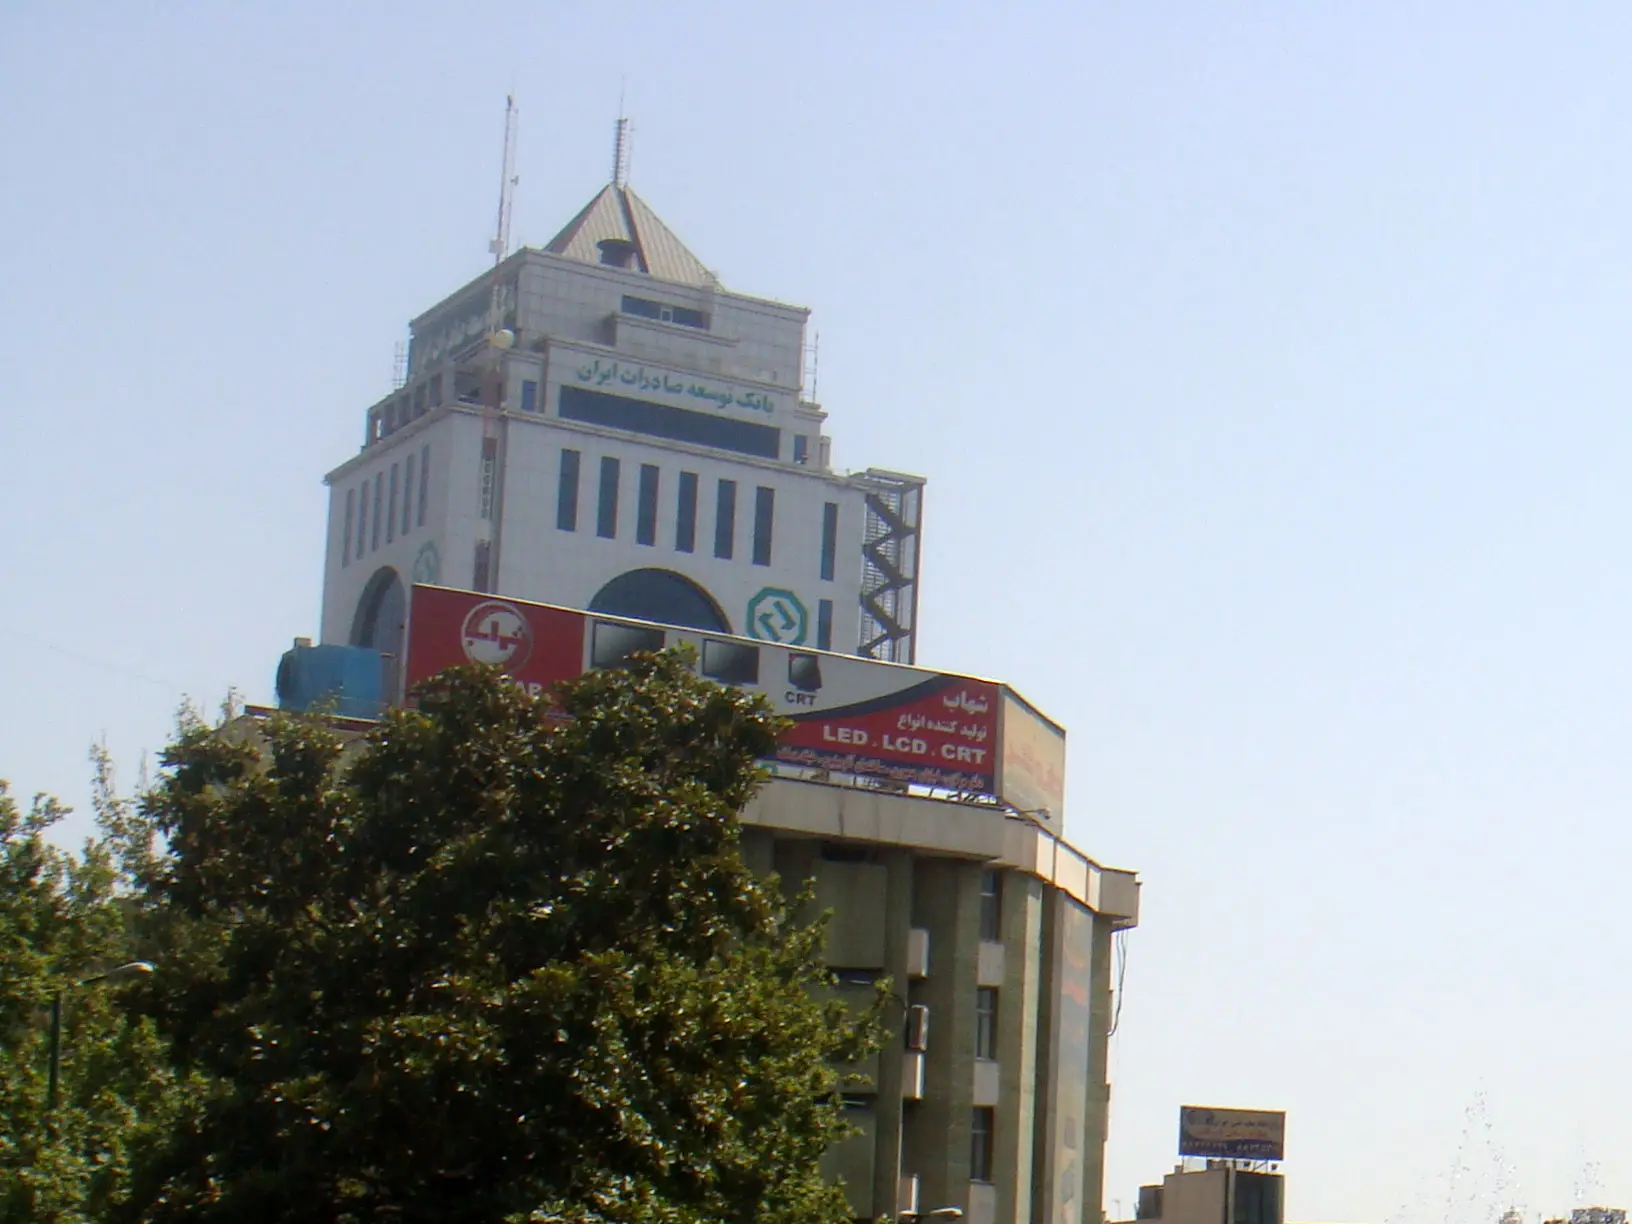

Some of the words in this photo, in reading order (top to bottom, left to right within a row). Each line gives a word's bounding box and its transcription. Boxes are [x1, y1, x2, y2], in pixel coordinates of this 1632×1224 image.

[577, 359, 618, 386] ایران
[687, 381, 734, 409] توسعه
[735, 392, 775, 418] بانک
[784, 690, 817, 706] CRT
[942, 690, 988, 715] شهاب
[896, 713, 926, 732] انواع
[927, 719, 958, 735] کننده
[960, 723, 988, 743] تولید
[823, 724, 869, 747] LED
[882, 734, 928, 756] LCD
[941, 743, 987, 765] CRT
